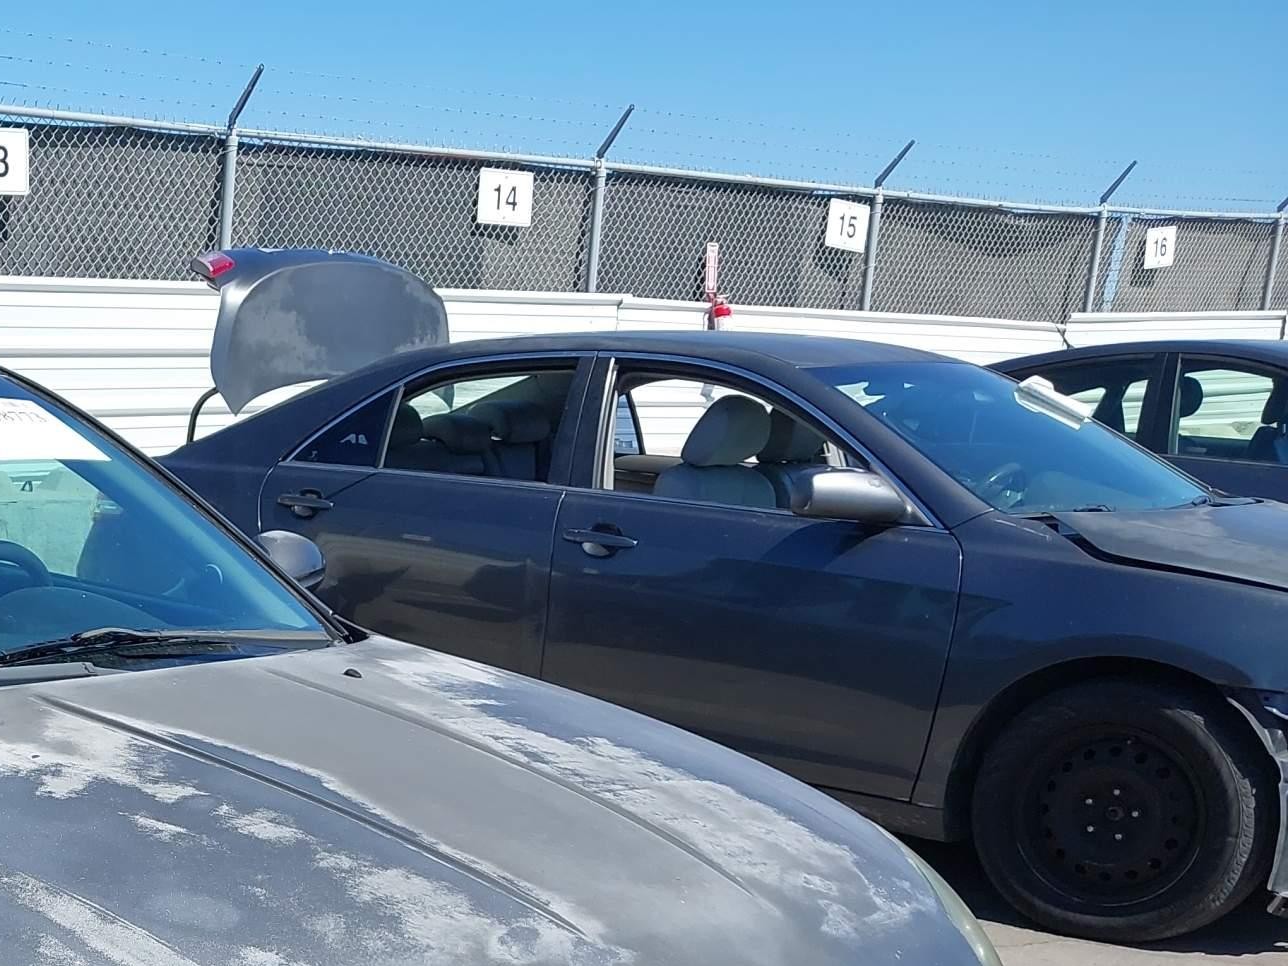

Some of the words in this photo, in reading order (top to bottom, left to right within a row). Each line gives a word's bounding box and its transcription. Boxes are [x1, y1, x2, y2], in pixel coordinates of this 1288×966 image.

[493, 184, 517, 212] 14
[839, 212, 857, 239] 15
[1153, 236, 1168, 258] 16
